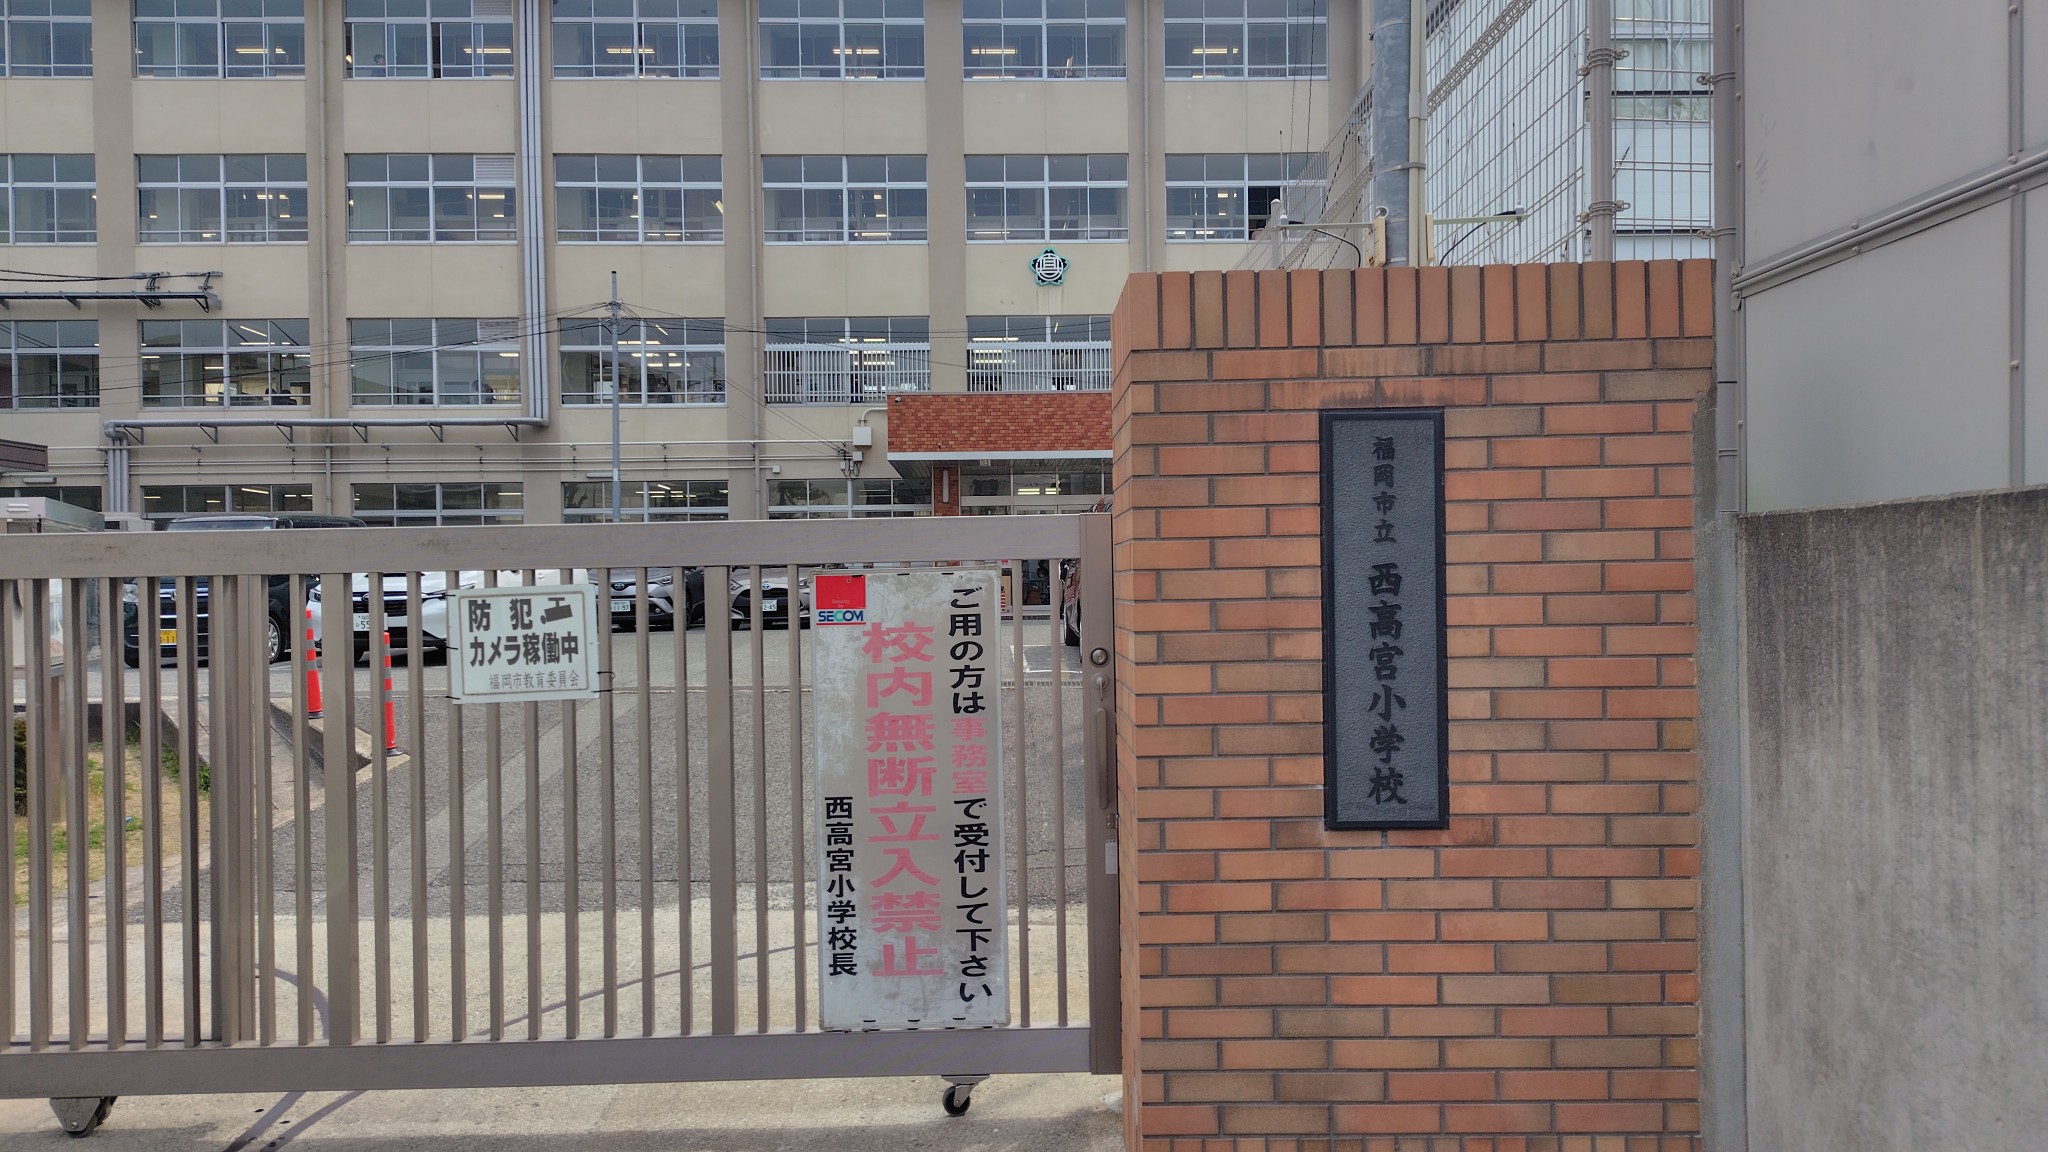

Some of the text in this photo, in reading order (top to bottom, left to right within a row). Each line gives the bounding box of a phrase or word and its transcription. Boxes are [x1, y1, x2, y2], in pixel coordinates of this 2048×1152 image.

[469, 631, 579, 667] カメラ稼働中
[489, 669, 580, 690] 福岡市教育委員会
[818, 610, 864, 622] SECOM
[1367, 436, 1407, 805] 福岡市立 西高宮小学校
[862, 621, 944, 977] 校内無断立入禁止
[948, 586, 993, 1003] ご用の方は事務室で受付して下さい
[824, 796, 858, 977] 西高宮小学校長
